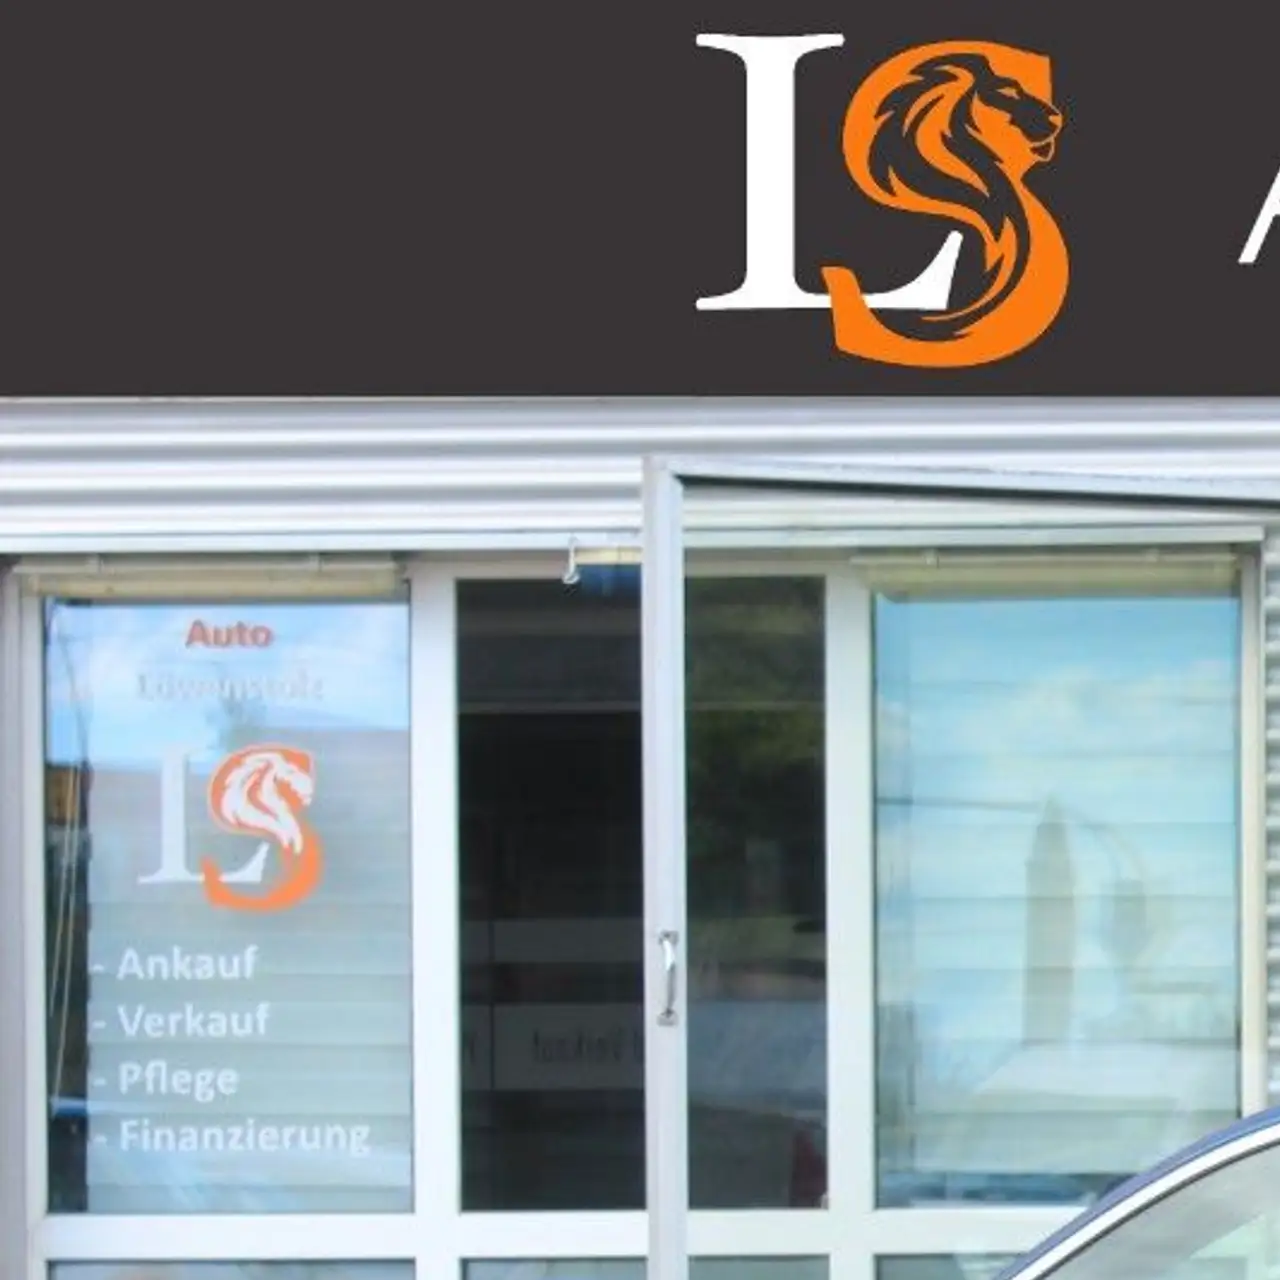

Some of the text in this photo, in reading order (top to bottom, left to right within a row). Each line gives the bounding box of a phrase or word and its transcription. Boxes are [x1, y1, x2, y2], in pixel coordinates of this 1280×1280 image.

[185, 618, 274, 649] Auto
[117, 945, 259, 980] Ankauf
[117, 1003, 270, 1038] Verkauf
[118, 1059, 239, 1102] Pflege
[118, 1118, 371, 1156] Finanzierung
